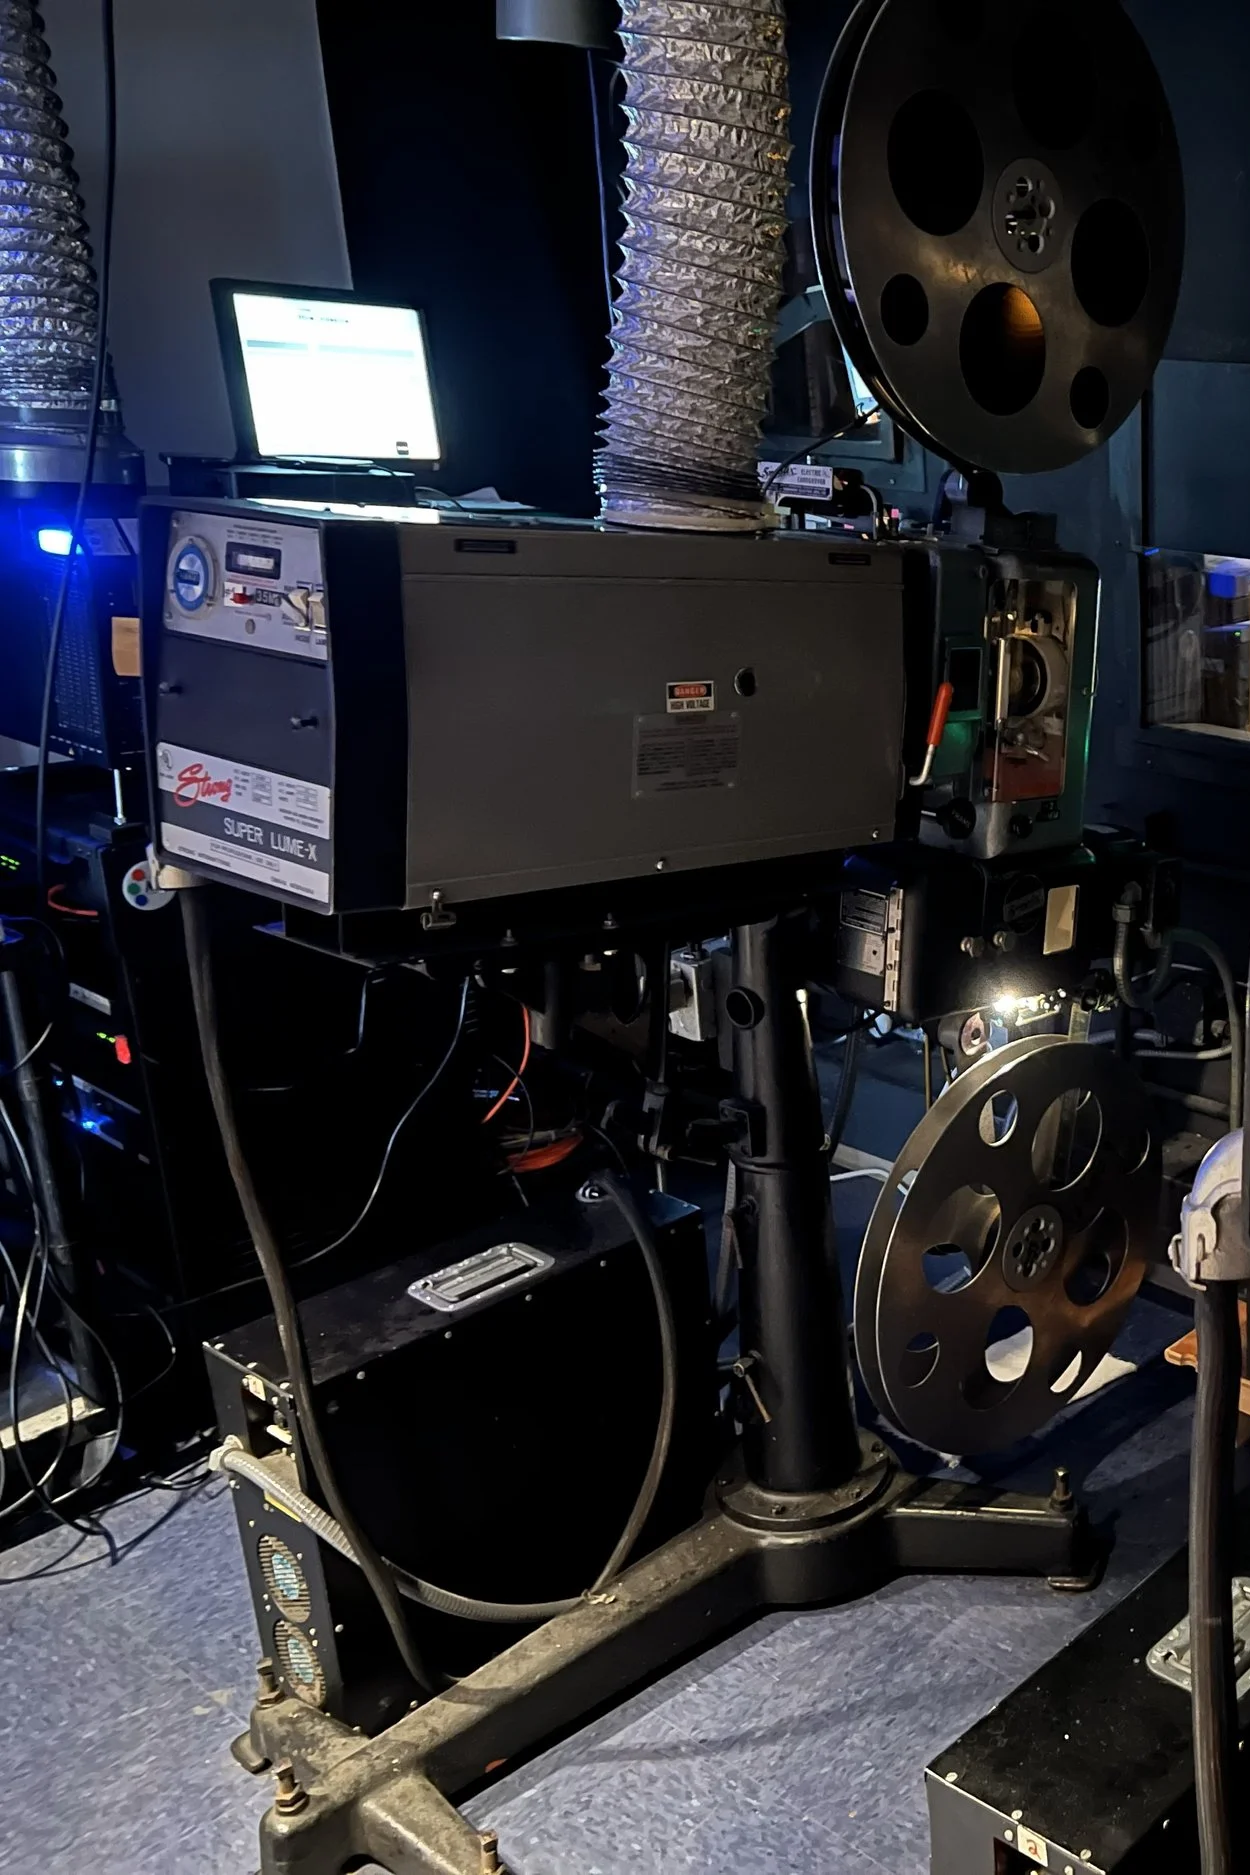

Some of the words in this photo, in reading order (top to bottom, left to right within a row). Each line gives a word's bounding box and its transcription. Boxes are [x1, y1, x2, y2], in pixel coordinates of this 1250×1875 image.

[686, 698, 711, 709] VOLTAGE
[173, 763, 233, 808] Strong
[223, 817, 264, 845] SUPER
[270, 831, 318, 863] LUME-X
